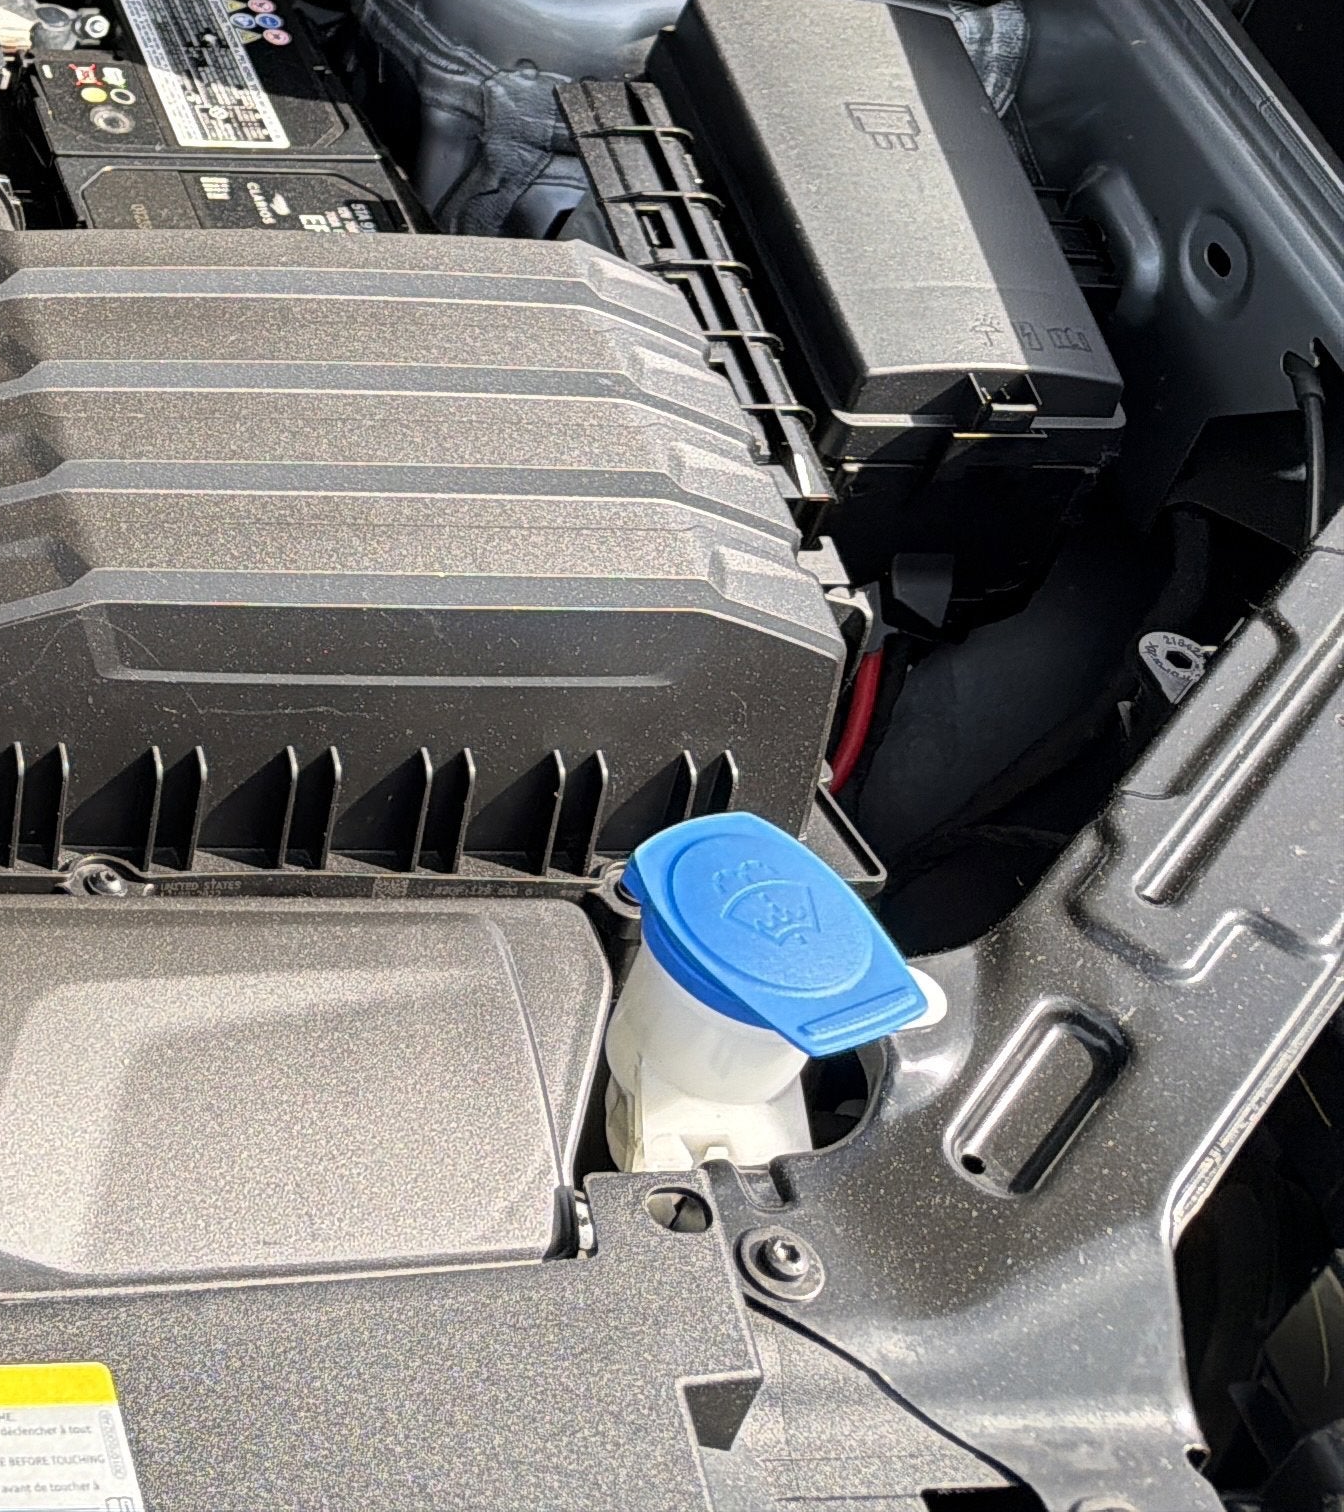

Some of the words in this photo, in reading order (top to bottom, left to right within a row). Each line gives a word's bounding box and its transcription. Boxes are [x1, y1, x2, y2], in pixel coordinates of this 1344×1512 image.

[246, 181, 277, 225] CLARIOS
[160, 881, 199, 891] UNITED
[204, 879, 242, 890] STATES
[69, 1425, 92, 1435] tout
[9, 1456, 49, 1466] BEFORE
[52, 1454, 106, 1465] TOUCHING
[2, 1483, 31, 1493] avant
[50, 1481, 91, 1492] toucher
